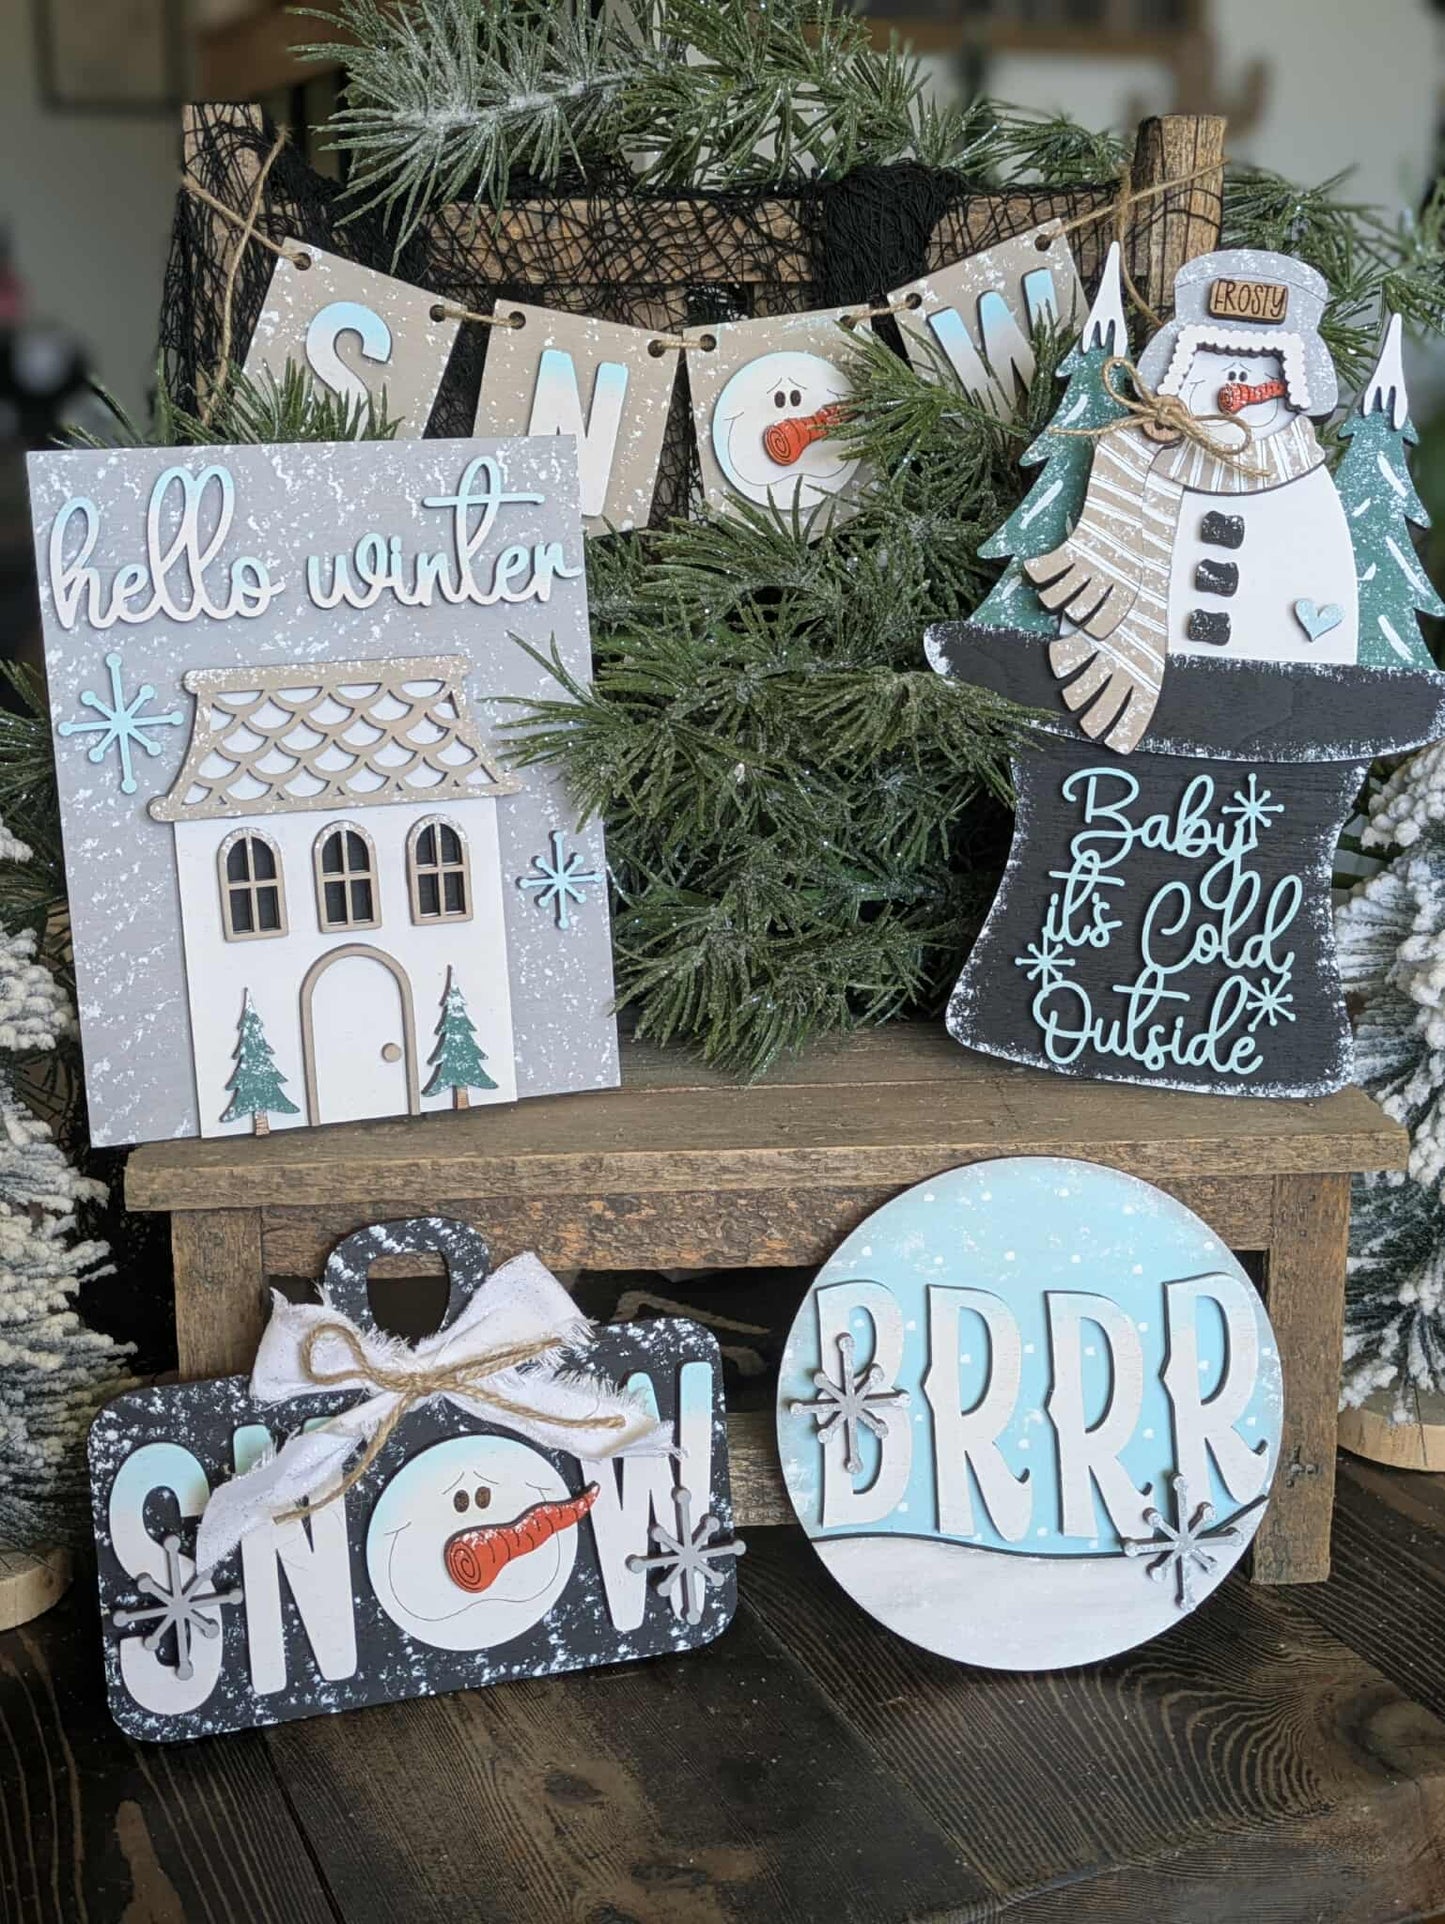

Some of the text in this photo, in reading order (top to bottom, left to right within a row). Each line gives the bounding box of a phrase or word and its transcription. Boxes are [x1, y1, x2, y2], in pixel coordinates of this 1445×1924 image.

[1213, 280, 1286, 317] FROSTY
[49, 456, 583, 629] hello winter
[1062, 767, 1258, 910] Baby
[1141, 870, 1303, 976] Cold
[1032, 966, 1264, 1075] Outside
[815, 1272, 1270, 1542] BRRR
